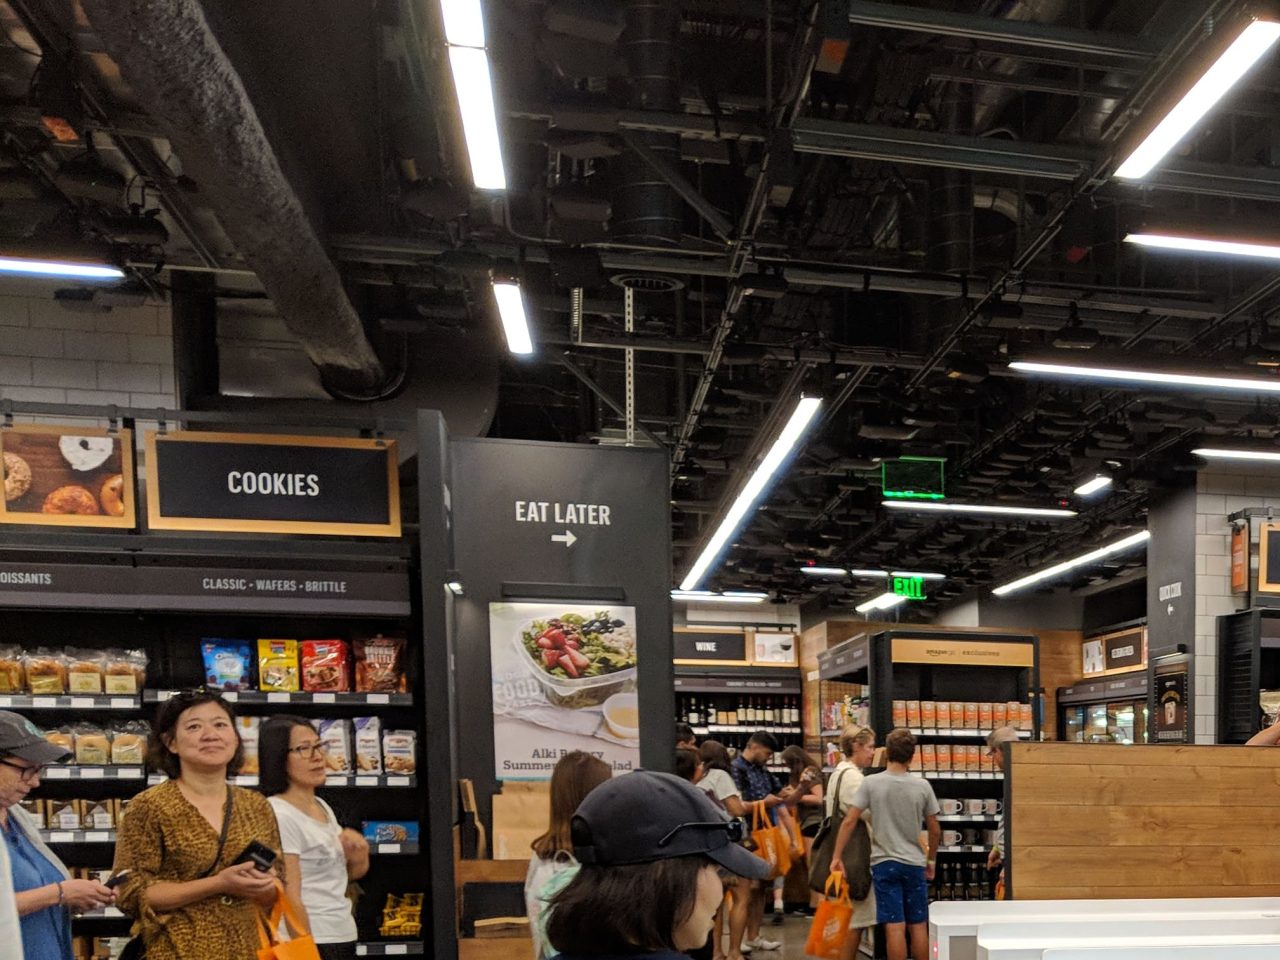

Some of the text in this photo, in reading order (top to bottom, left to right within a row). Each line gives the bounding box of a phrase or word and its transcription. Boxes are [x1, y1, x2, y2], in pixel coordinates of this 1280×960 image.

[228, 471, 320, 497] COOKIES
[515, 500, 611, 526] EAT LATER
[0, 571, 52, 585] OISSANTS
[202, 577, 347, 593] CLASSIC WAFERS BRITTLE
[893, 576, 923, 597] EXIT
[695, 641, 717, 652] WINE
[531, 748, 557, 759] Alki
